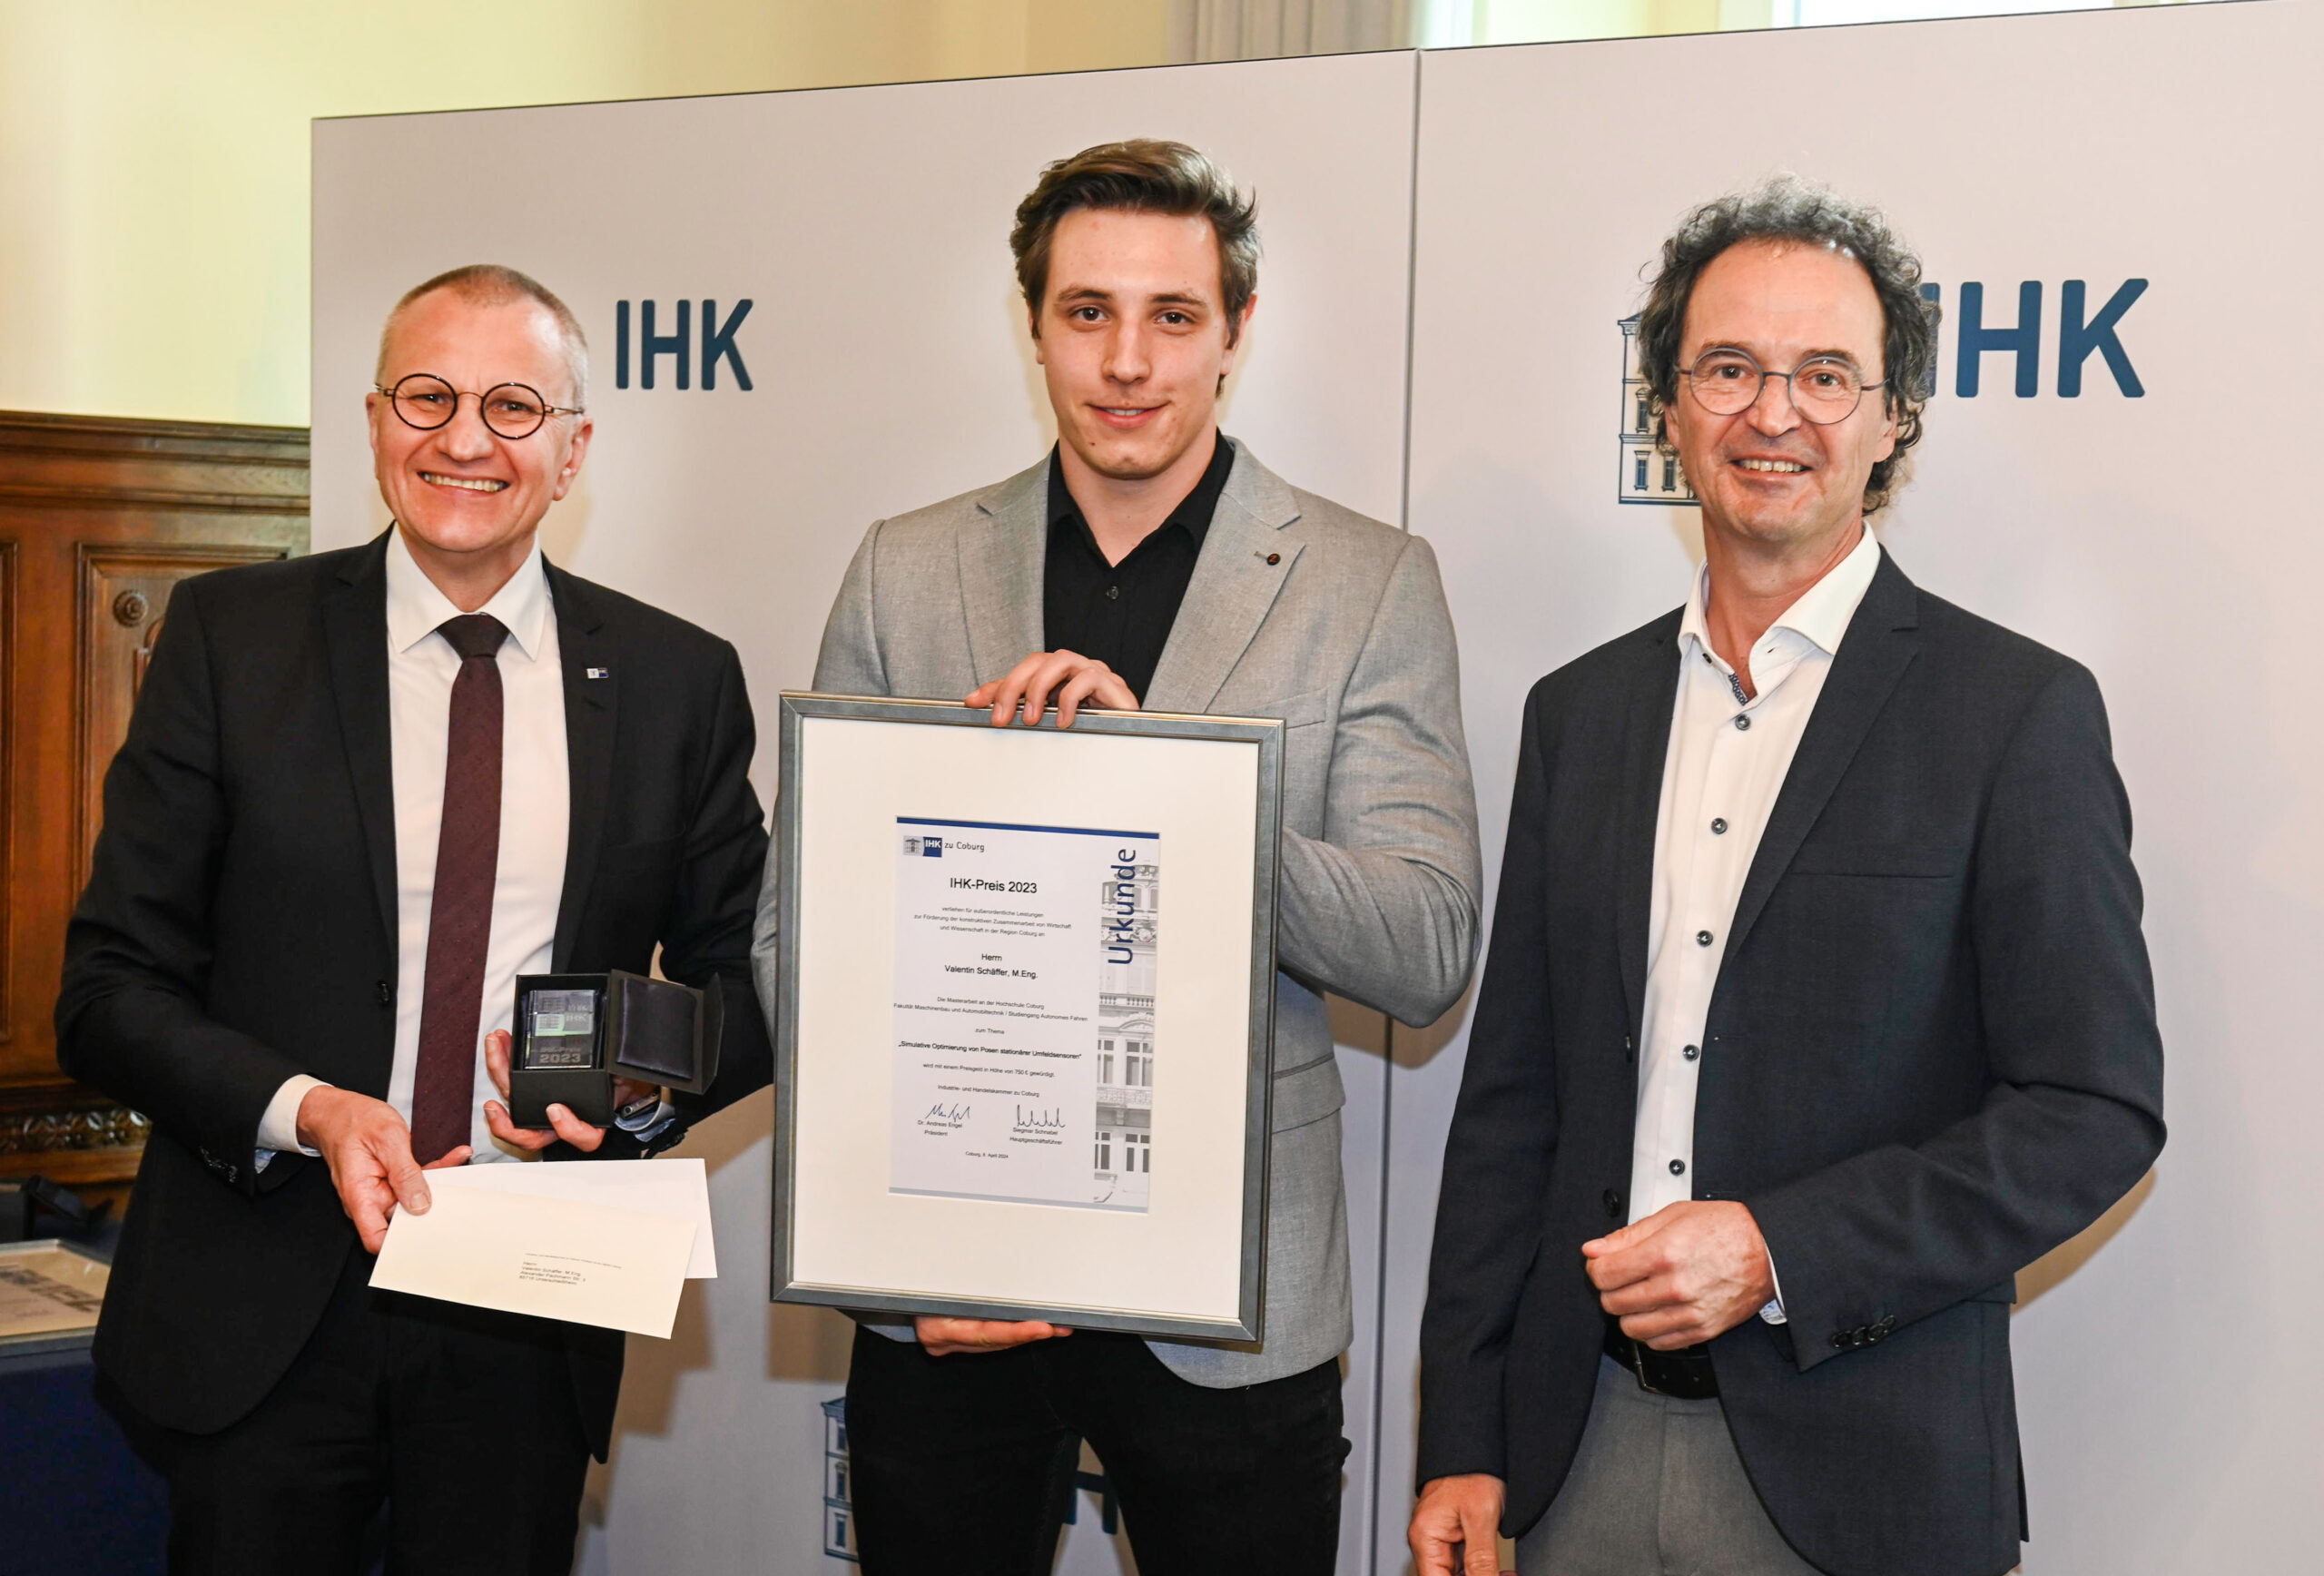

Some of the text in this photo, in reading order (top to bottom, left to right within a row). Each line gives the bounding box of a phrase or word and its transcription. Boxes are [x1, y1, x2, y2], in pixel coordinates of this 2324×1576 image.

[615, 299, 753, 391] IHK
[1919, 278, 2149, 398] IHK
[925, 839, 941, 849] IHK
[956, 841, 985, 853] Coburg
[950, 878, 1038, 893] IHK-Preis 2023
[1108, 848, 1137, 965] Urkunde
[944, 965, 1039, 980] Valentin Schäffer, M.Eng.
[931, 1043, 967, 1052] Optimierung
[539, 1054, 581, 1063] 2023
